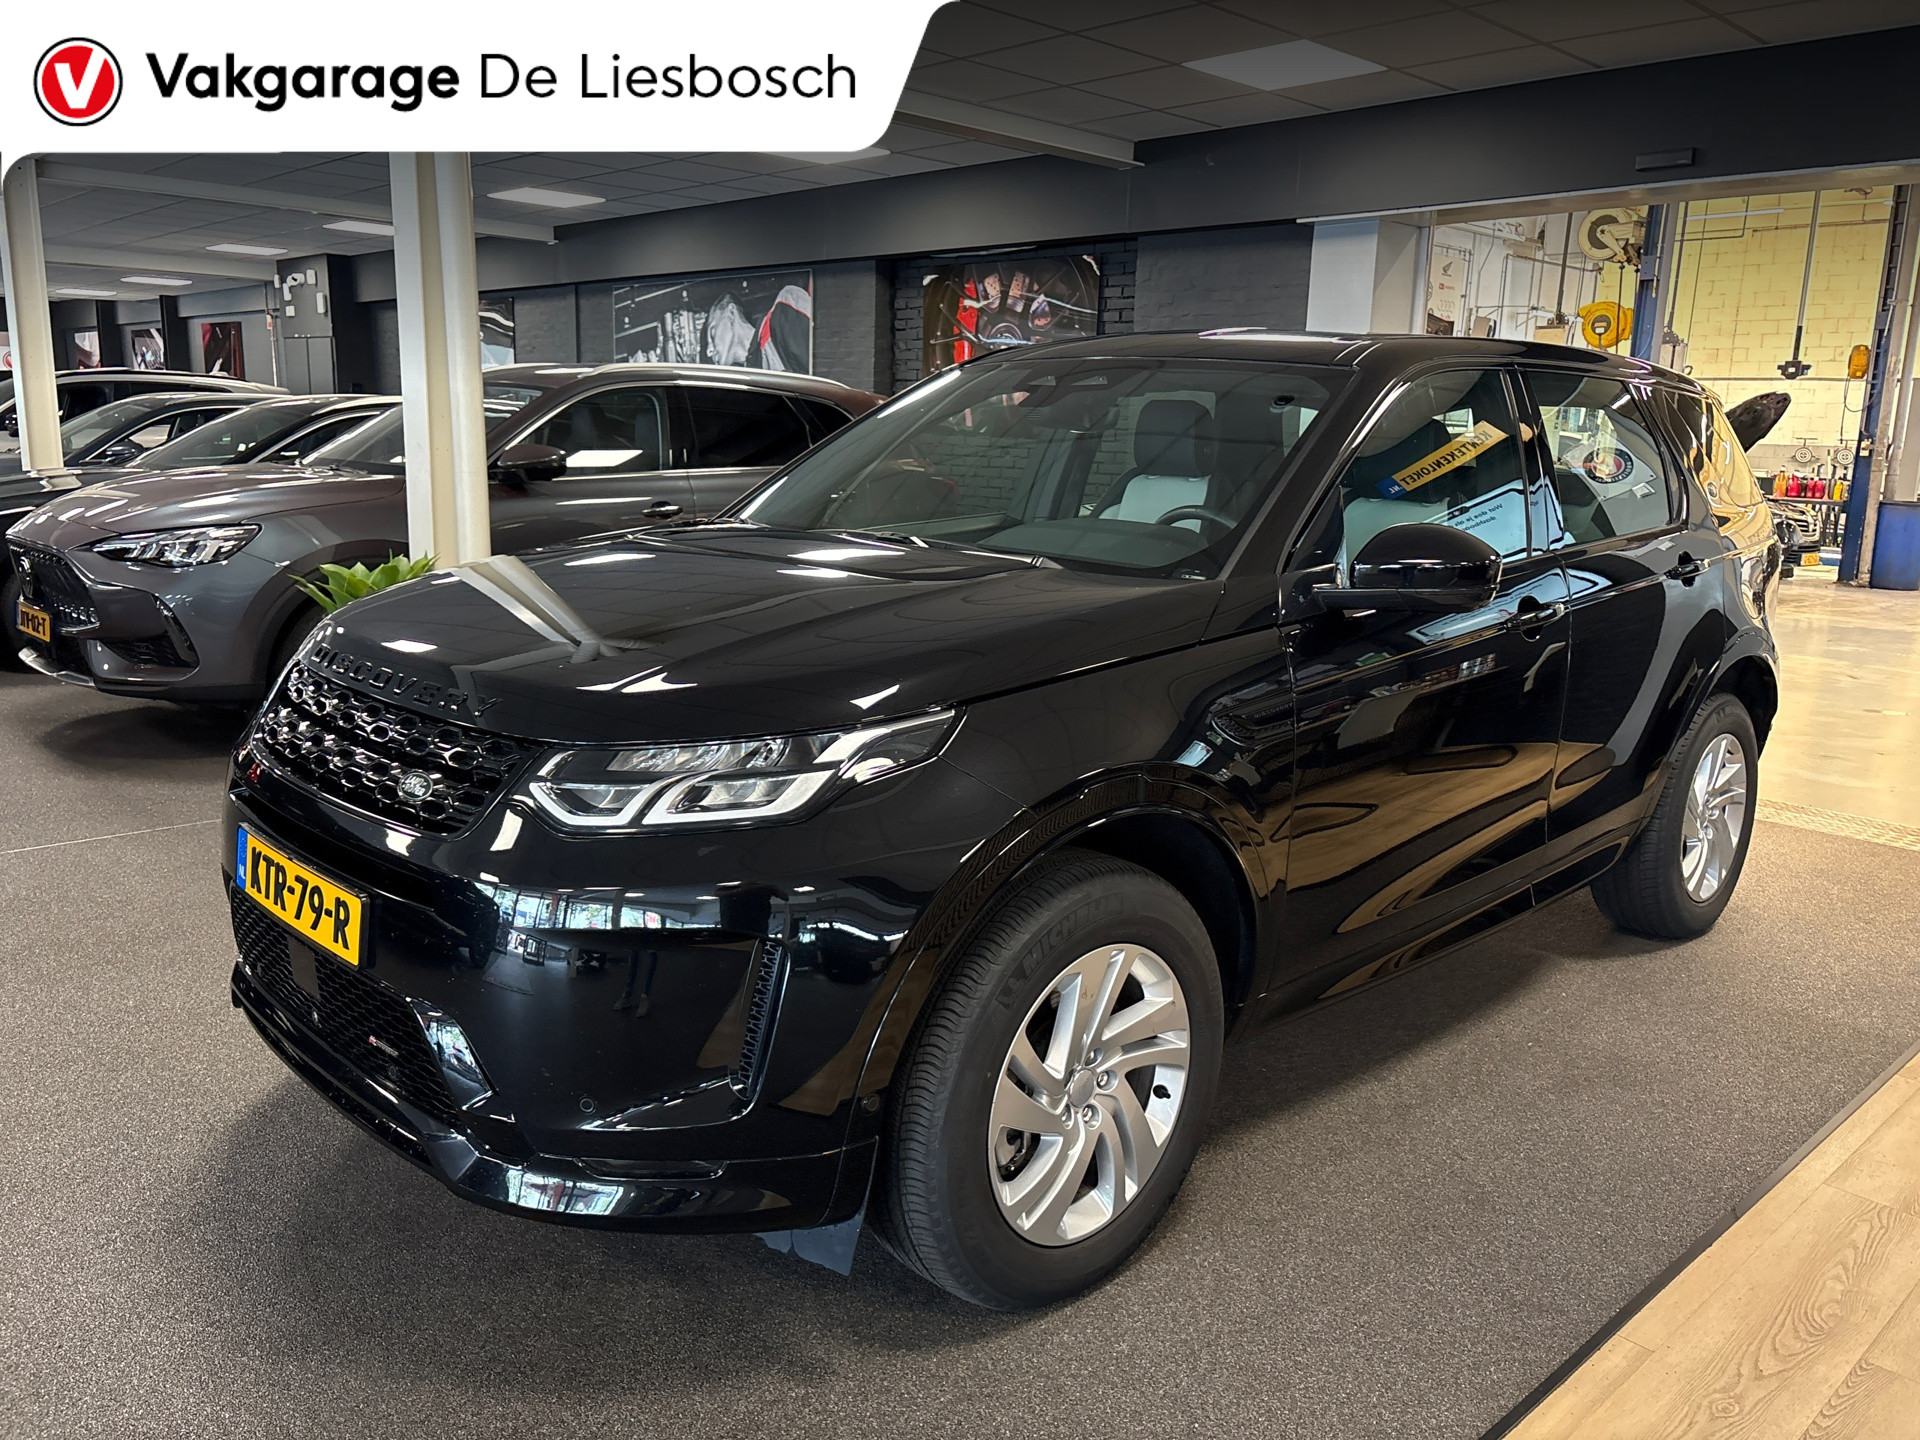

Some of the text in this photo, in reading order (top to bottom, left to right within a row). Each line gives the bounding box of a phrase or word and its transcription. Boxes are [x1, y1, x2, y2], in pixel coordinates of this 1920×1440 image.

[311, 643, 503, 717] DISCOVERY
[238, 846, 350, 951] NL KTR-79-R
